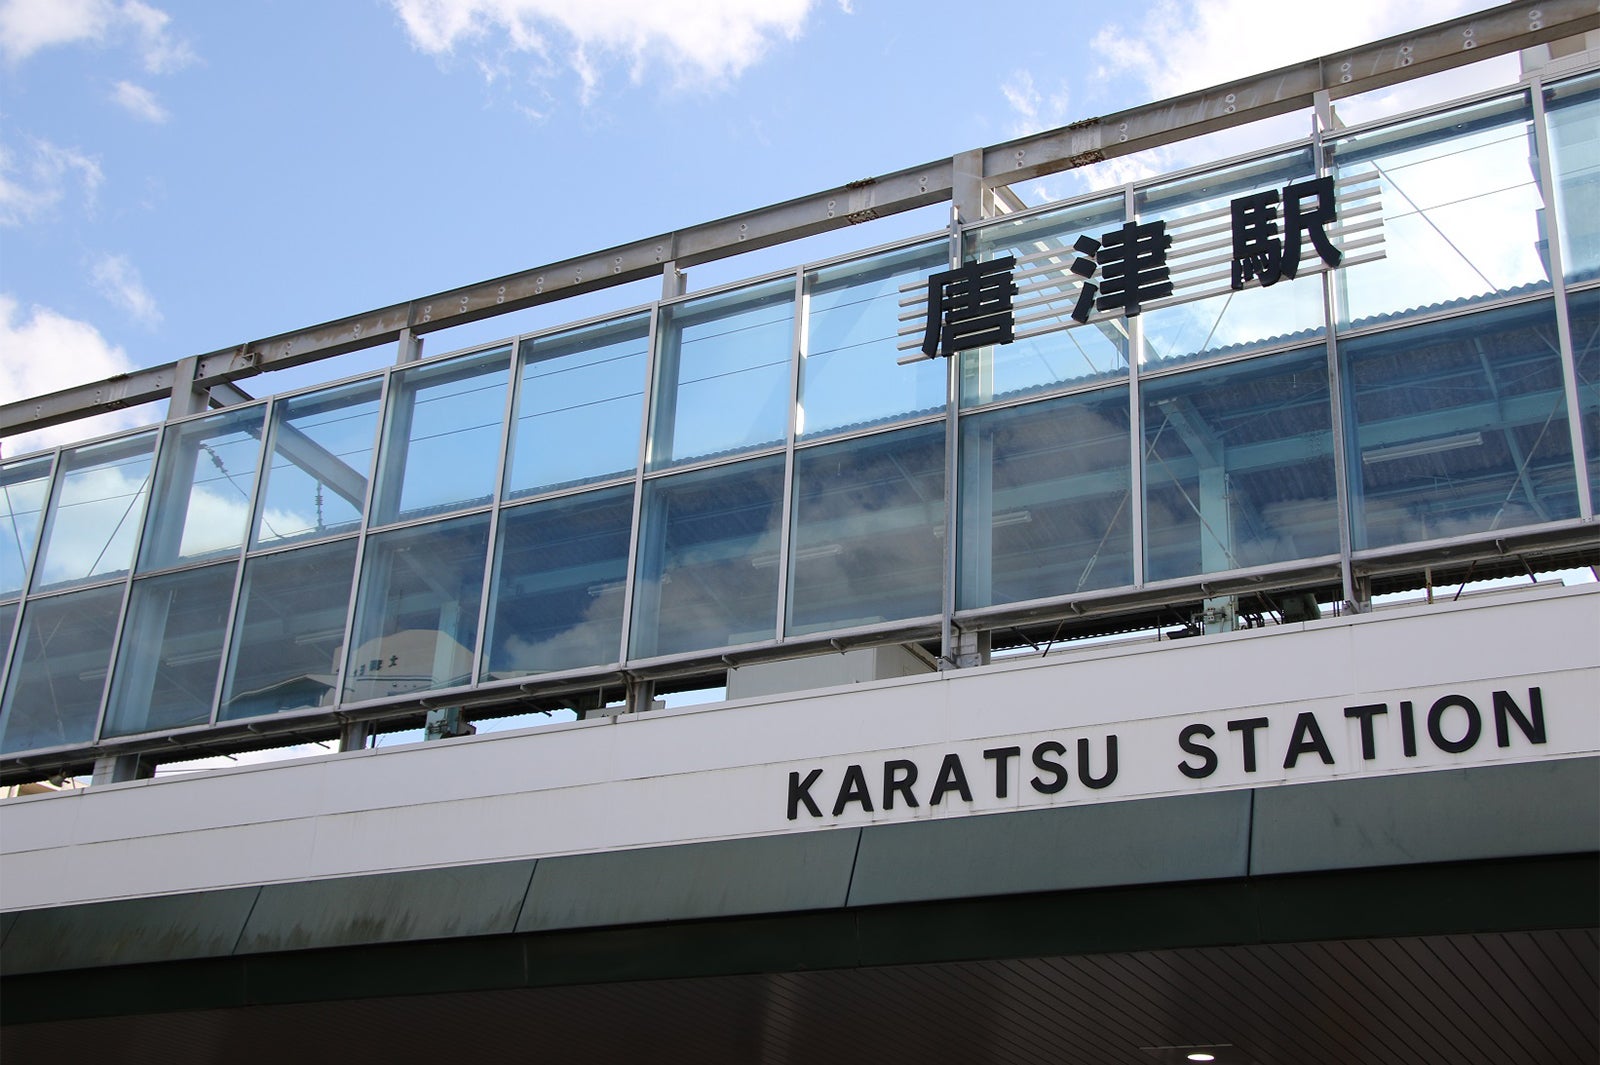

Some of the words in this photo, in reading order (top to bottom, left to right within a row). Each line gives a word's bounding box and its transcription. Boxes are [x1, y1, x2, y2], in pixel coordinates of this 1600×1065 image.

[922, 176, 1342, 360] 唐津駅
[787, 735, 1119, 821] KARATSU
[1178, 686, 1547, 779] STATION
